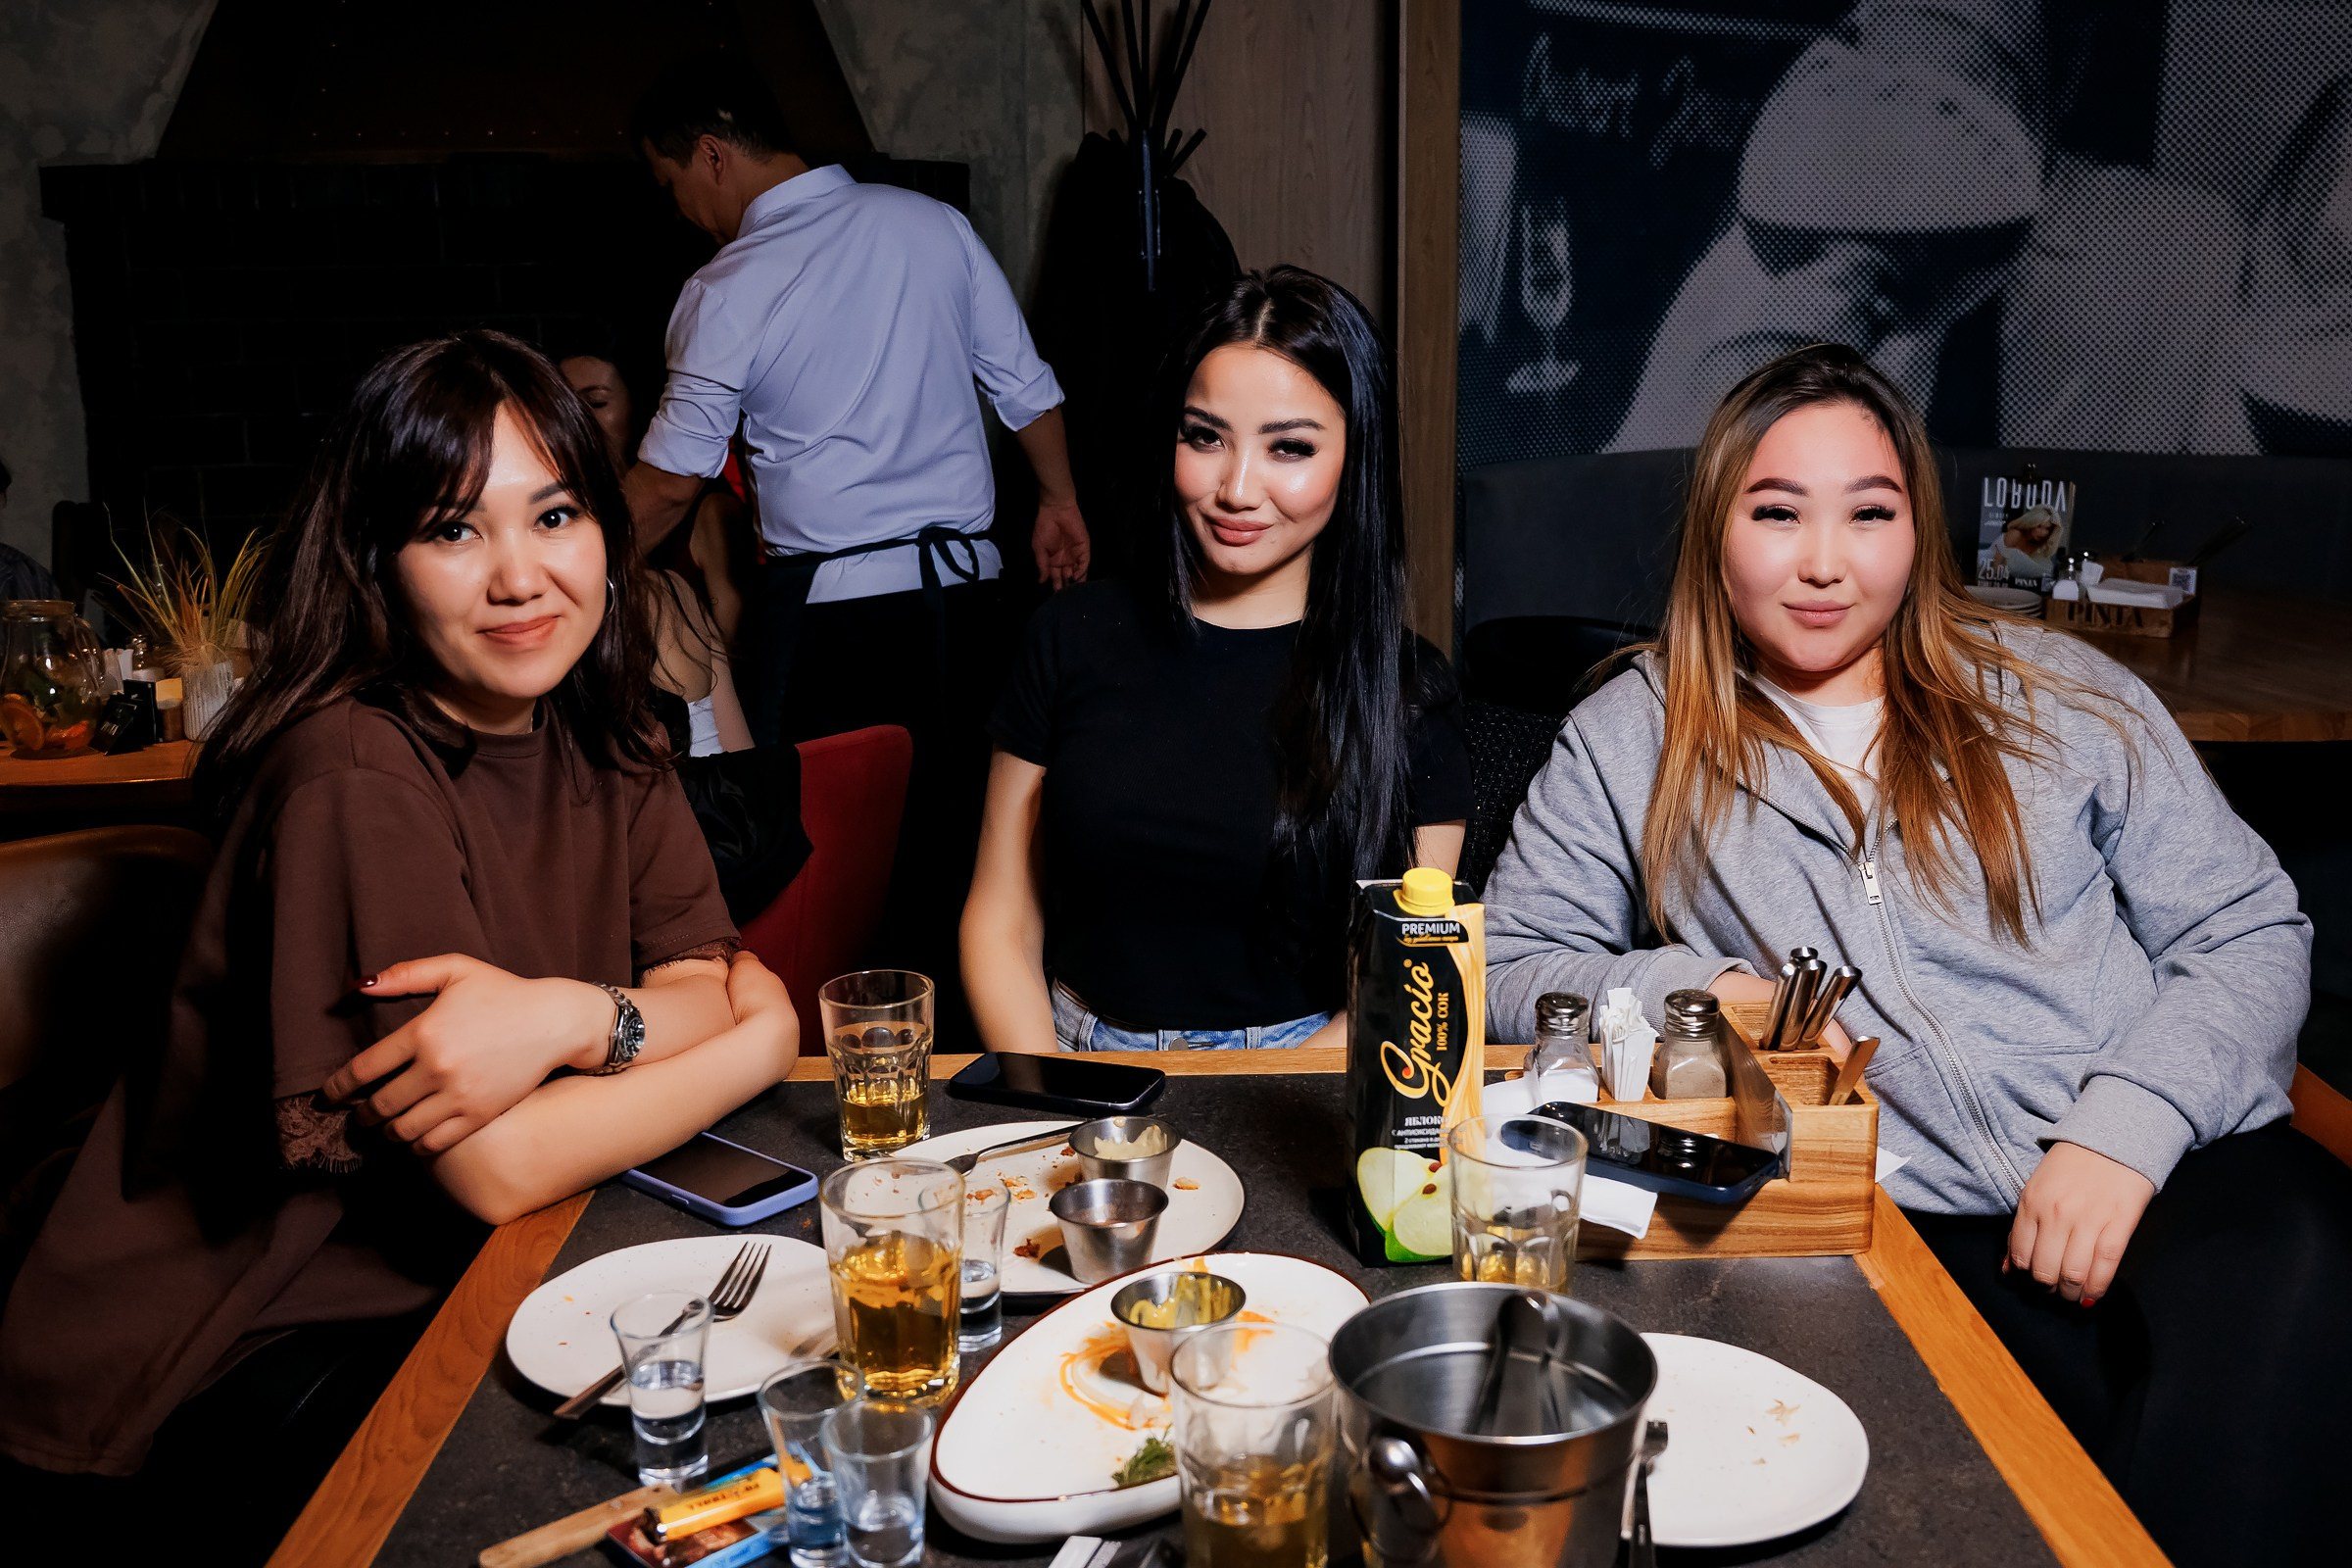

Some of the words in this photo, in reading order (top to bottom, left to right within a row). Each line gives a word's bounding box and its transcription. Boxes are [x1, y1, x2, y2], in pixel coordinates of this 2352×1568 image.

[2067, 602, 2144, 628] PINTA
[1401, 922, 1461, 935] PREMIUM
[1436, 992, 1448, 1018] СОК
[1380, 961, 1452, 1106] Gracio
[1436, 1021, 1448, 1052] 100%
